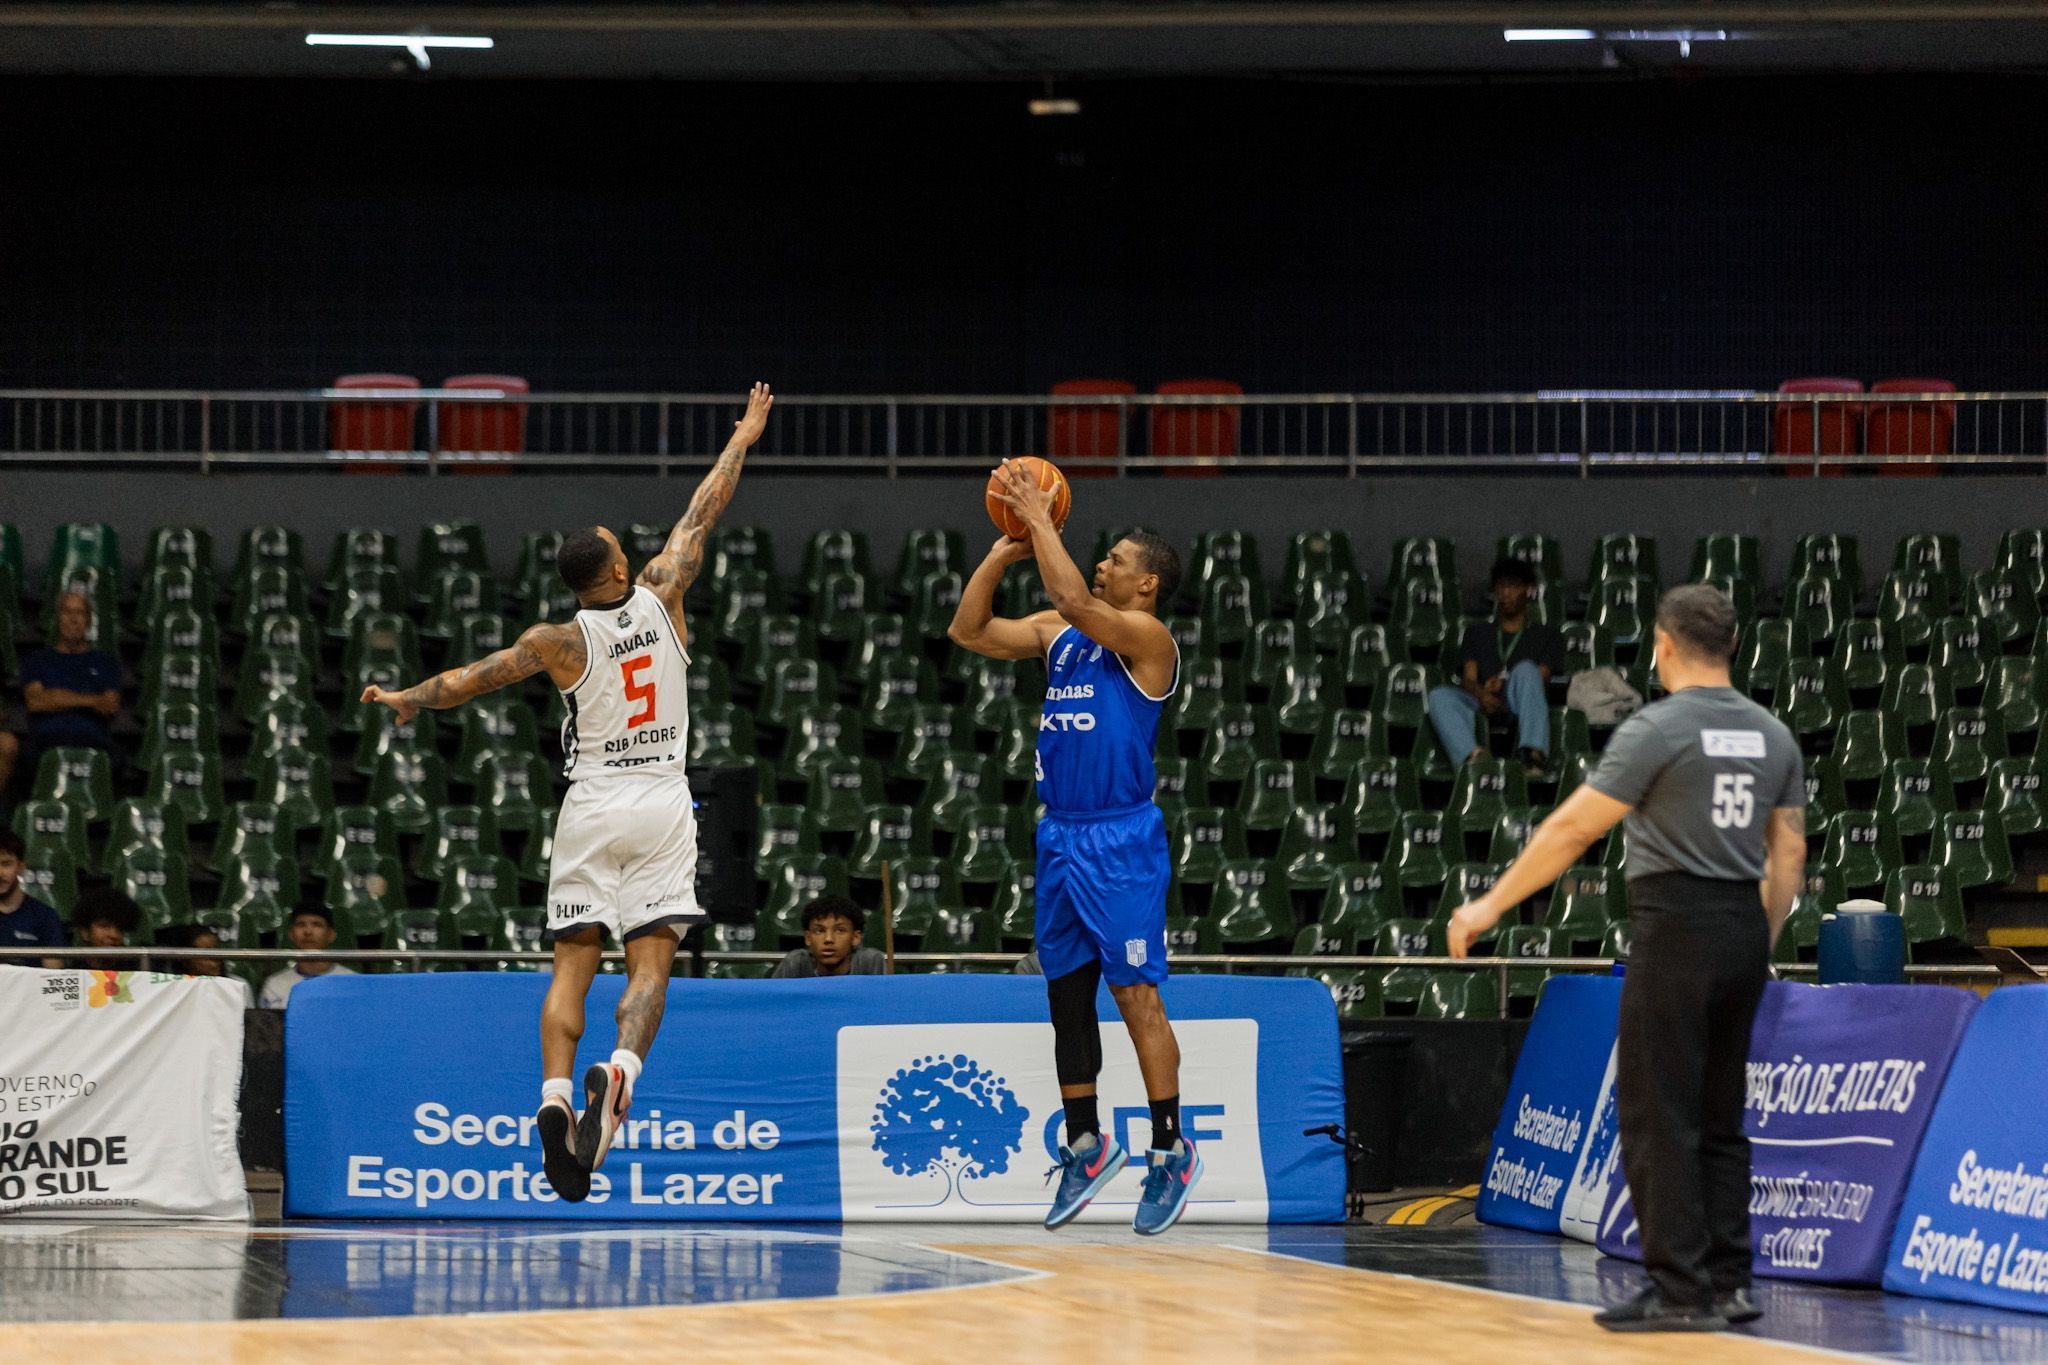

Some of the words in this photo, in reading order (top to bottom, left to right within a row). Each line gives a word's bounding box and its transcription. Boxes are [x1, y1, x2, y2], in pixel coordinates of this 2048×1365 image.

[620, 654, 656, 729] 5
[1040, 712, 1096, 731] KTO
[1711, 773, 1755, 829] 55
[1924, 881, 1940, 896] 19
[1803, 1062, 1846, 1114] DE
[1830, 1058, 1927, 1114] ATLETAS
[0, 1119, 39, 1143] IO
[413, 1101, 696, 1151] Secrria
[712, 1109, 781, 1151] de
[1513, 1093, 1568, 1151] Secretaria
[1562, 1109, 1582, 1155] de
[0, 1135, 128, 1173] RANDE
[1486, 1146, 1527, 1201] Esporte
[1522, 1169, 1535, 1202] e
[1529, 1161, 1564, 1210] Lazer
[0, 1175, 26, 1201] O
[36, 1171, 110, 1197] SUL
[346, 1155, 559, 1208] Esporte
[585, 1171, 612, 1204] e
[630, 1162, 784, 1206] Lazer
[1902, 1214, 1985, 1285] Esporte
[1981, 1242, 2001, 1285] e
[1997, 1232, 2048, 1294] Laze
